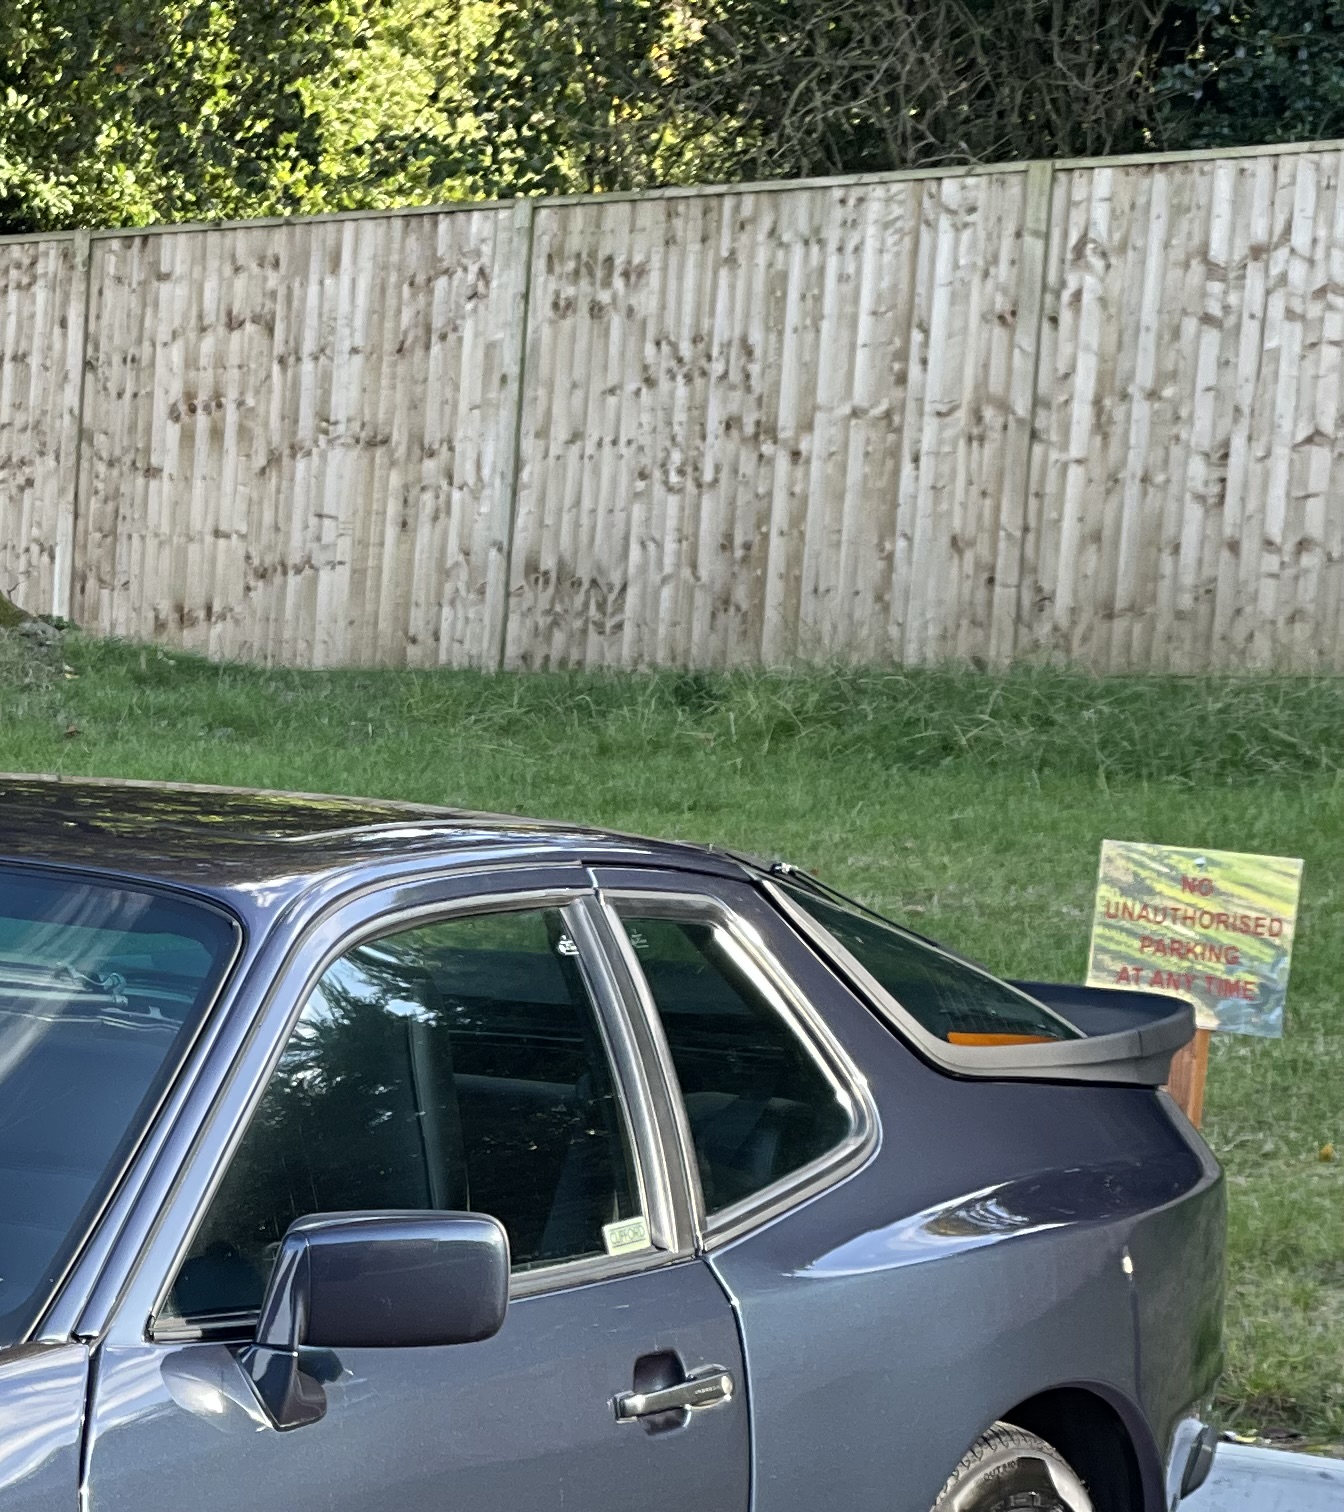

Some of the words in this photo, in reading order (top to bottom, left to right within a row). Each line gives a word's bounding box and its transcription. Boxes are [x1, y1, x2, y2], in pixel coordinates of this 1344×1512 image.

[1181, 875, 1213, 897] NO
[1104, 899, 1283, 938] UNAUTHORISED
[1140, 935, 1240, 966] PARKING
[1116, 966, 1143, 986] AT
[1149, 970, 1195, 992] ANY
[1205, 975, 1256, 1001] TIME
[609, 1225, 646, 1245] CLIFFORD
